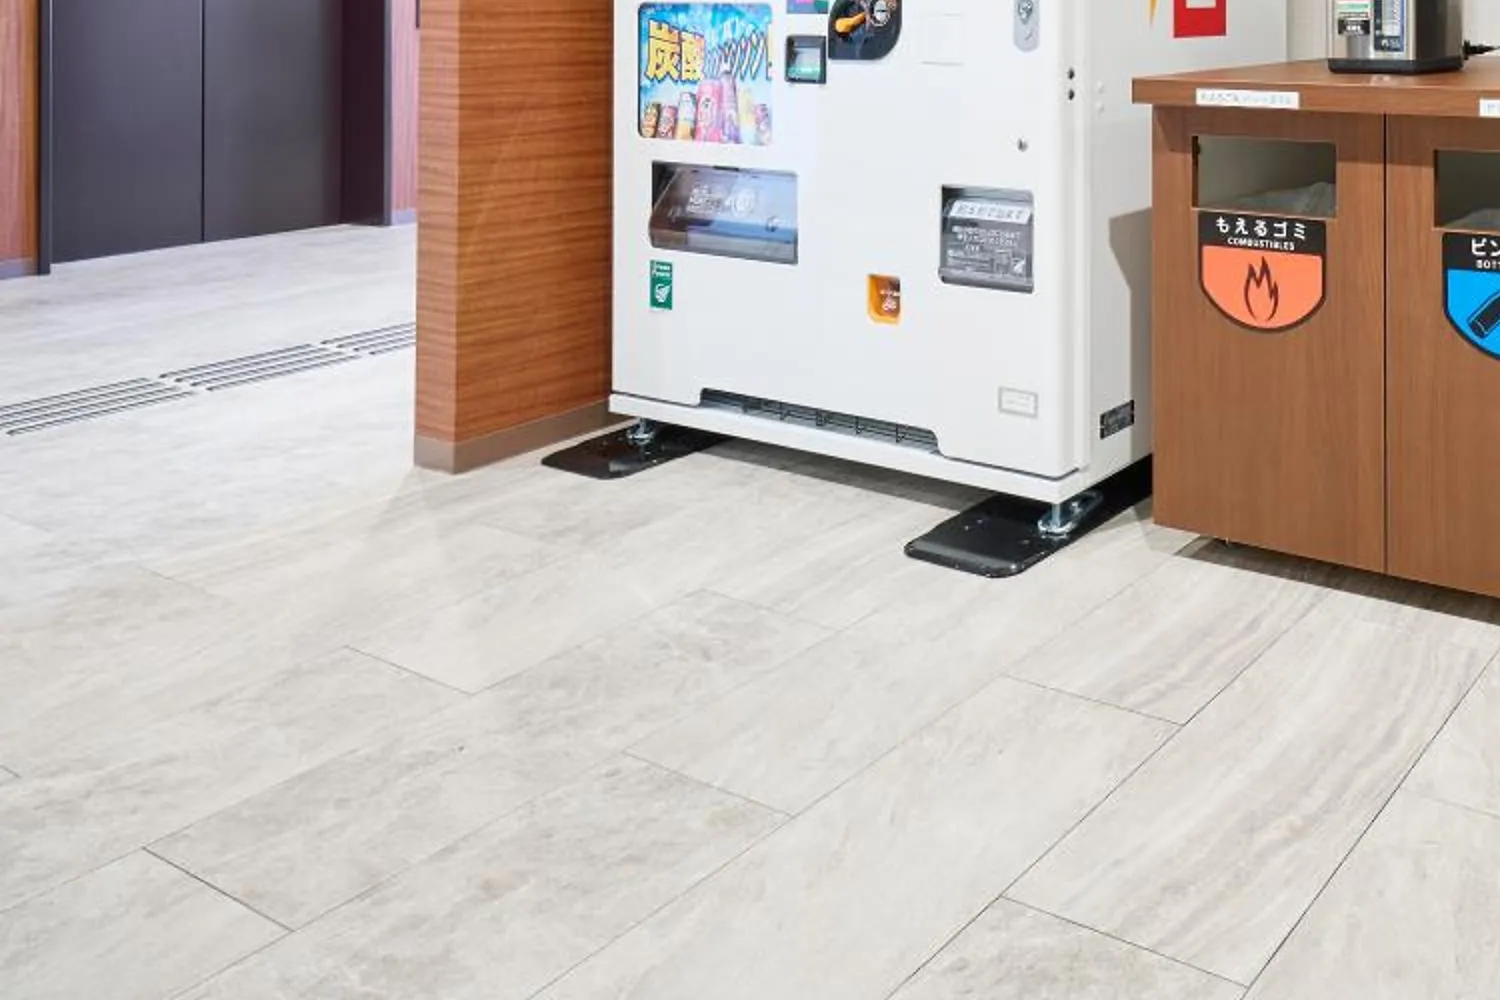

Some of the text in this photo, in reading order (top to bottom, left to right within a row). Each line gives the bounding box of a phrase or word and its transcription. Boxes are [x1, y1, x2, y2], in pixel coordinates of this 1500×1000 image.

[1216, 216, 1306, 240] もえるゴミ
[1227, 237, 1295, 251] COMBUSTIBLES
